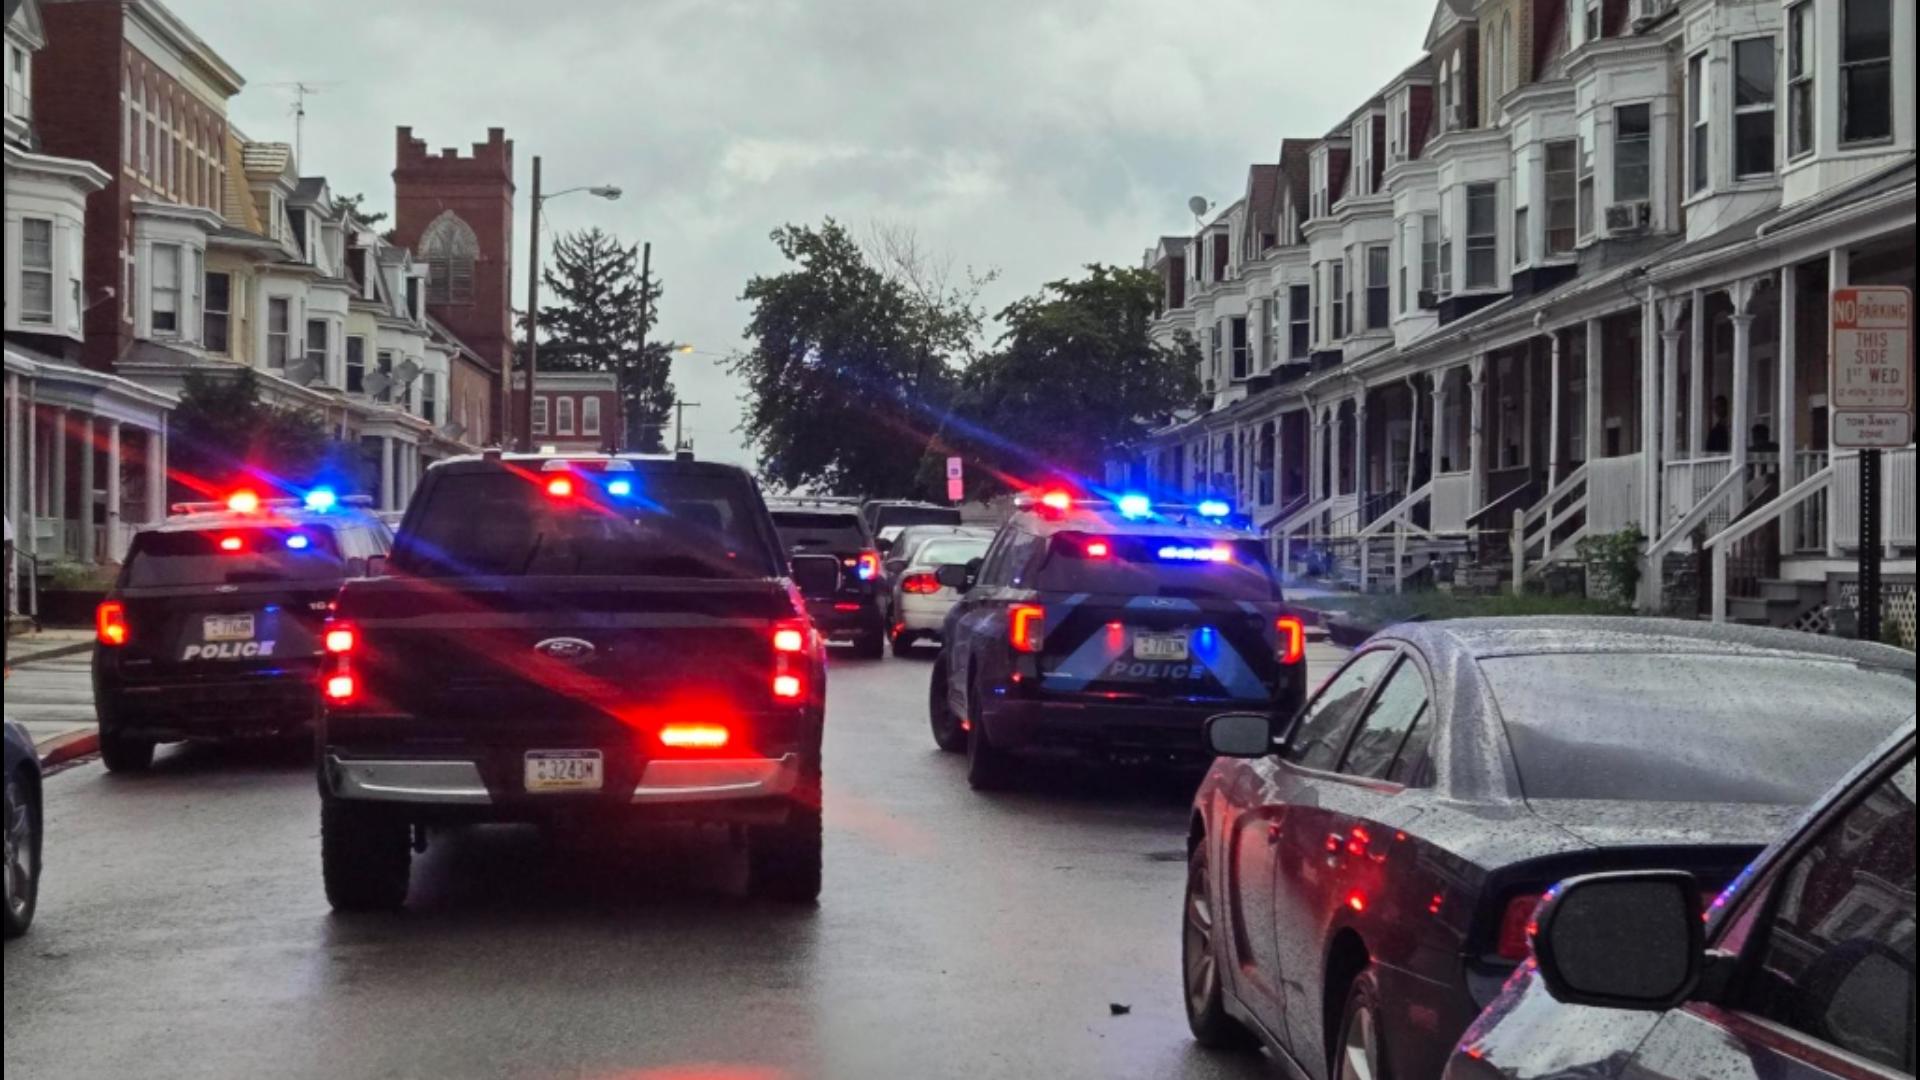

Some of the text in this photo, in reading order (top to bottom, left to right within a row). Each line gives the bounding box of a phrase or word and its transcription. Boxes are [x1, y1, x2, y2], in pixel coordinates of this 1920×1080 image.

[1836, 300, 1906, 323] NO PARKING
[1856, 332, 1888, 348] THIS
[1855, 349, 1888, 365] SIDE
[1869, 368, 1899, 384] WED
[182, 640, 276, 661] POLICE
[1109, 661, 1207, 680] POLICE
